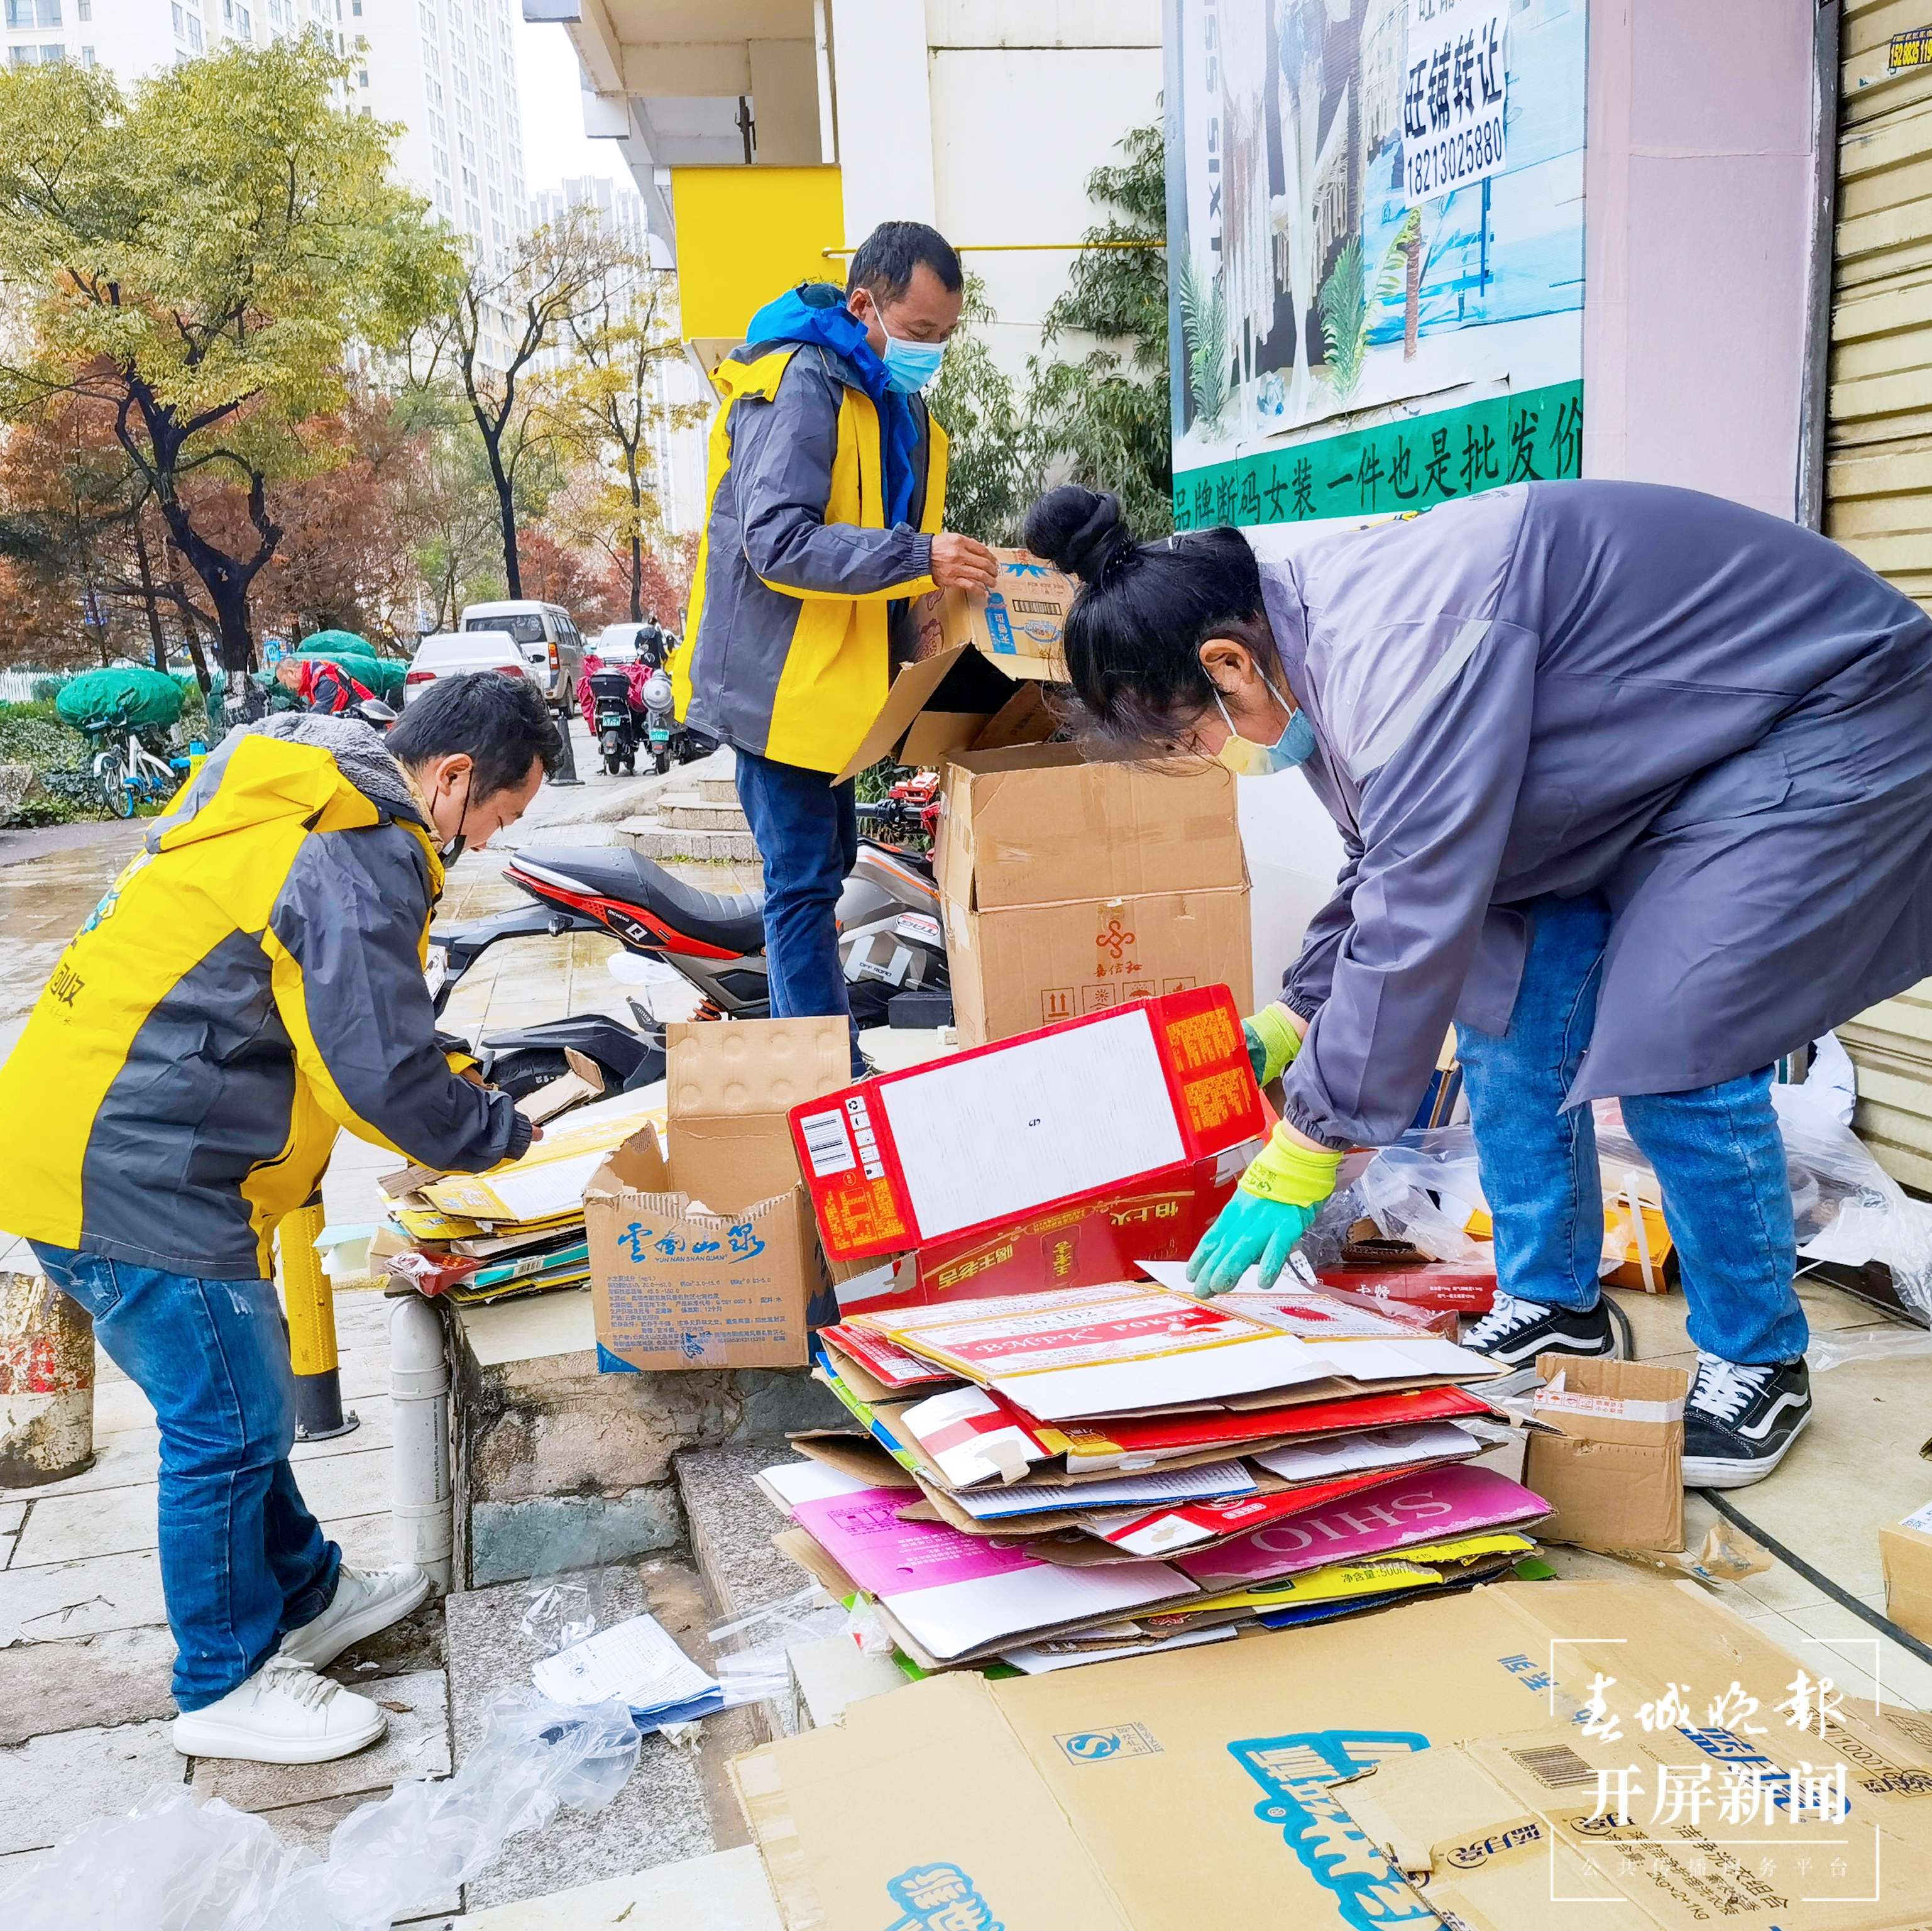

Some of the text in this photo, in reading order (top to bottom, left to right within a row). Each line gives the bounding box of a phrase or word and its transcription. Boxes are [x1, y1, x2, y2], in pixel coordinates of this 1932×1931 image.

[1404, 17, 1502, 139] 旺铺转让
[1408, 117, 1502, 197] 18213025880
[1173, 397, 1583, 530] 品牌断码女装 一件也是批发价
[1110, 1201, 1179, 1226] 怕上火
[938, 1243, 1013, 1290] 喝王老吉
[1052, 1240, 1071, 1277] 王老吉
